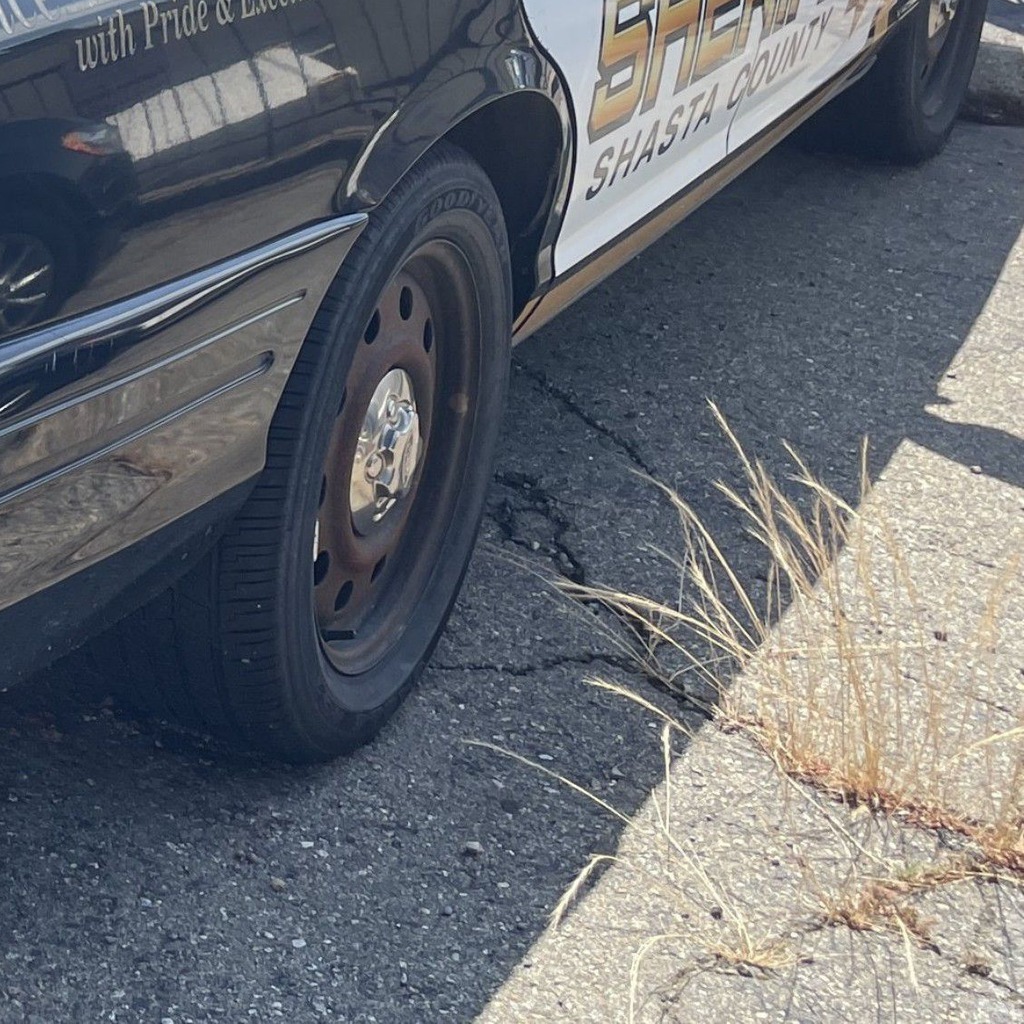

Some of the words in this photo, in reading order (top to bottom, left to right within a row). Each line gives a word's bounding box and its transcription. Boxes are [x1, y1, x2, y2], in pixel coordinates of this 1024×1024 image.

[75, 9, 137, 73] with
[584, 88, 717, 201] SHASTA
[726, 6, 835, 111] COUNTY
